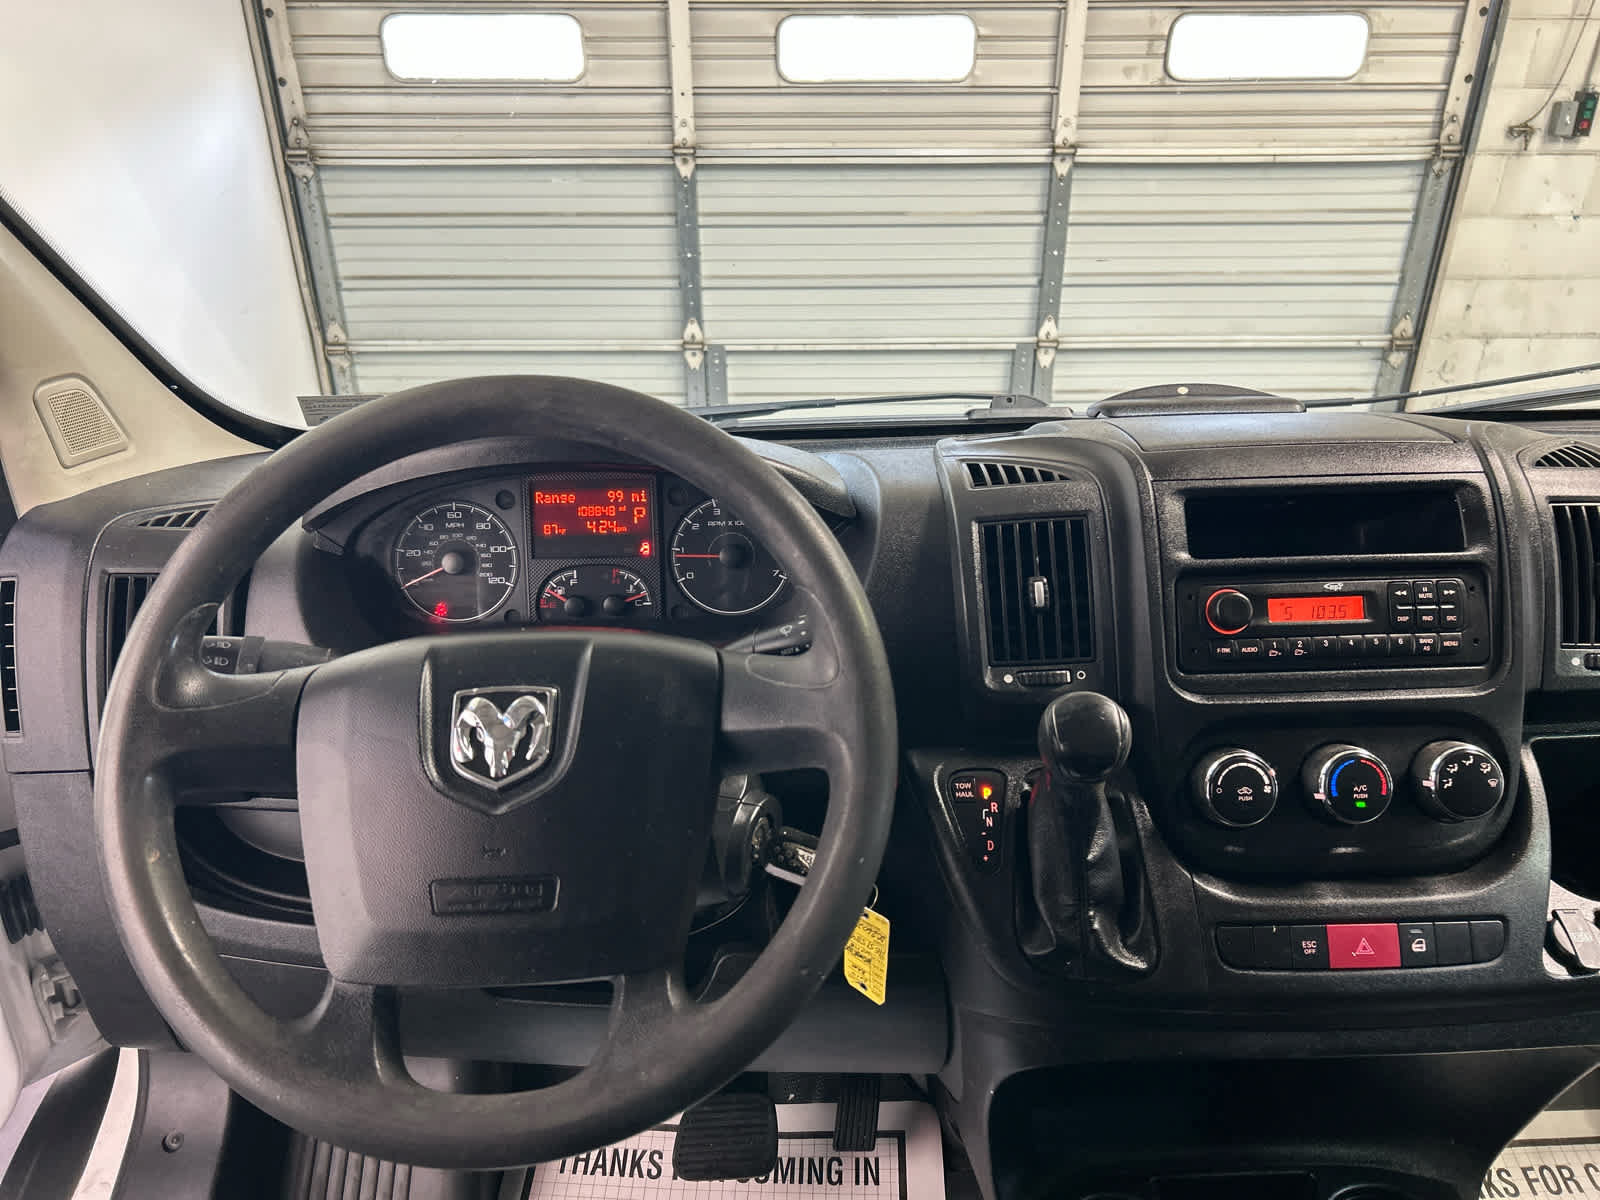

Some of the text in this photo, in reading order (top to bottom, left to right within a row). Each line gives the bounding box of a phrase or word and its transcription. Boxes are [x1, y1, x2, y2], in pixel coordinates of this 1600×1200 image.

[535, 490, 647, 504] Range 99 mi
[447, 511, 463, 519] 60
[634, 507, 646, 524] P
[713, 508, 721, 516] 3
[419, 523, 434, 531] 40
[476, 522, 491, 530] 80
[406, 549, 421, 557] 20
[686, 571, 694, 580] 0
[772, 569, 780, 577] 7
[488, 577, 505, 585] 120
[570, 579, 578, 587] F
[1272, 641, 1277, 649] 1
[1297, 640, 1303, 648] 2
[1323, 639, 1329, 647] 3
[1348, 638, 1354, 646] 4
[1373, 638, 1379, 646] 5
[1398, 637, 1404, 645] 6
[955, 782, 972, 790] TOW
[1353, 784, 1368, 792] A/C
[983, 786, 992, 800] P
[990, 801, 999, 813] R
[986, 816, 993, 828] N
[987, 840, 995, 851] D
[1302, 941, 1317, 949] ESC
[736, 1156, 844, 1186] MING
[854, 1156, 880, 1186] IN
[1520, 1164, 1584, 1197] FOR
